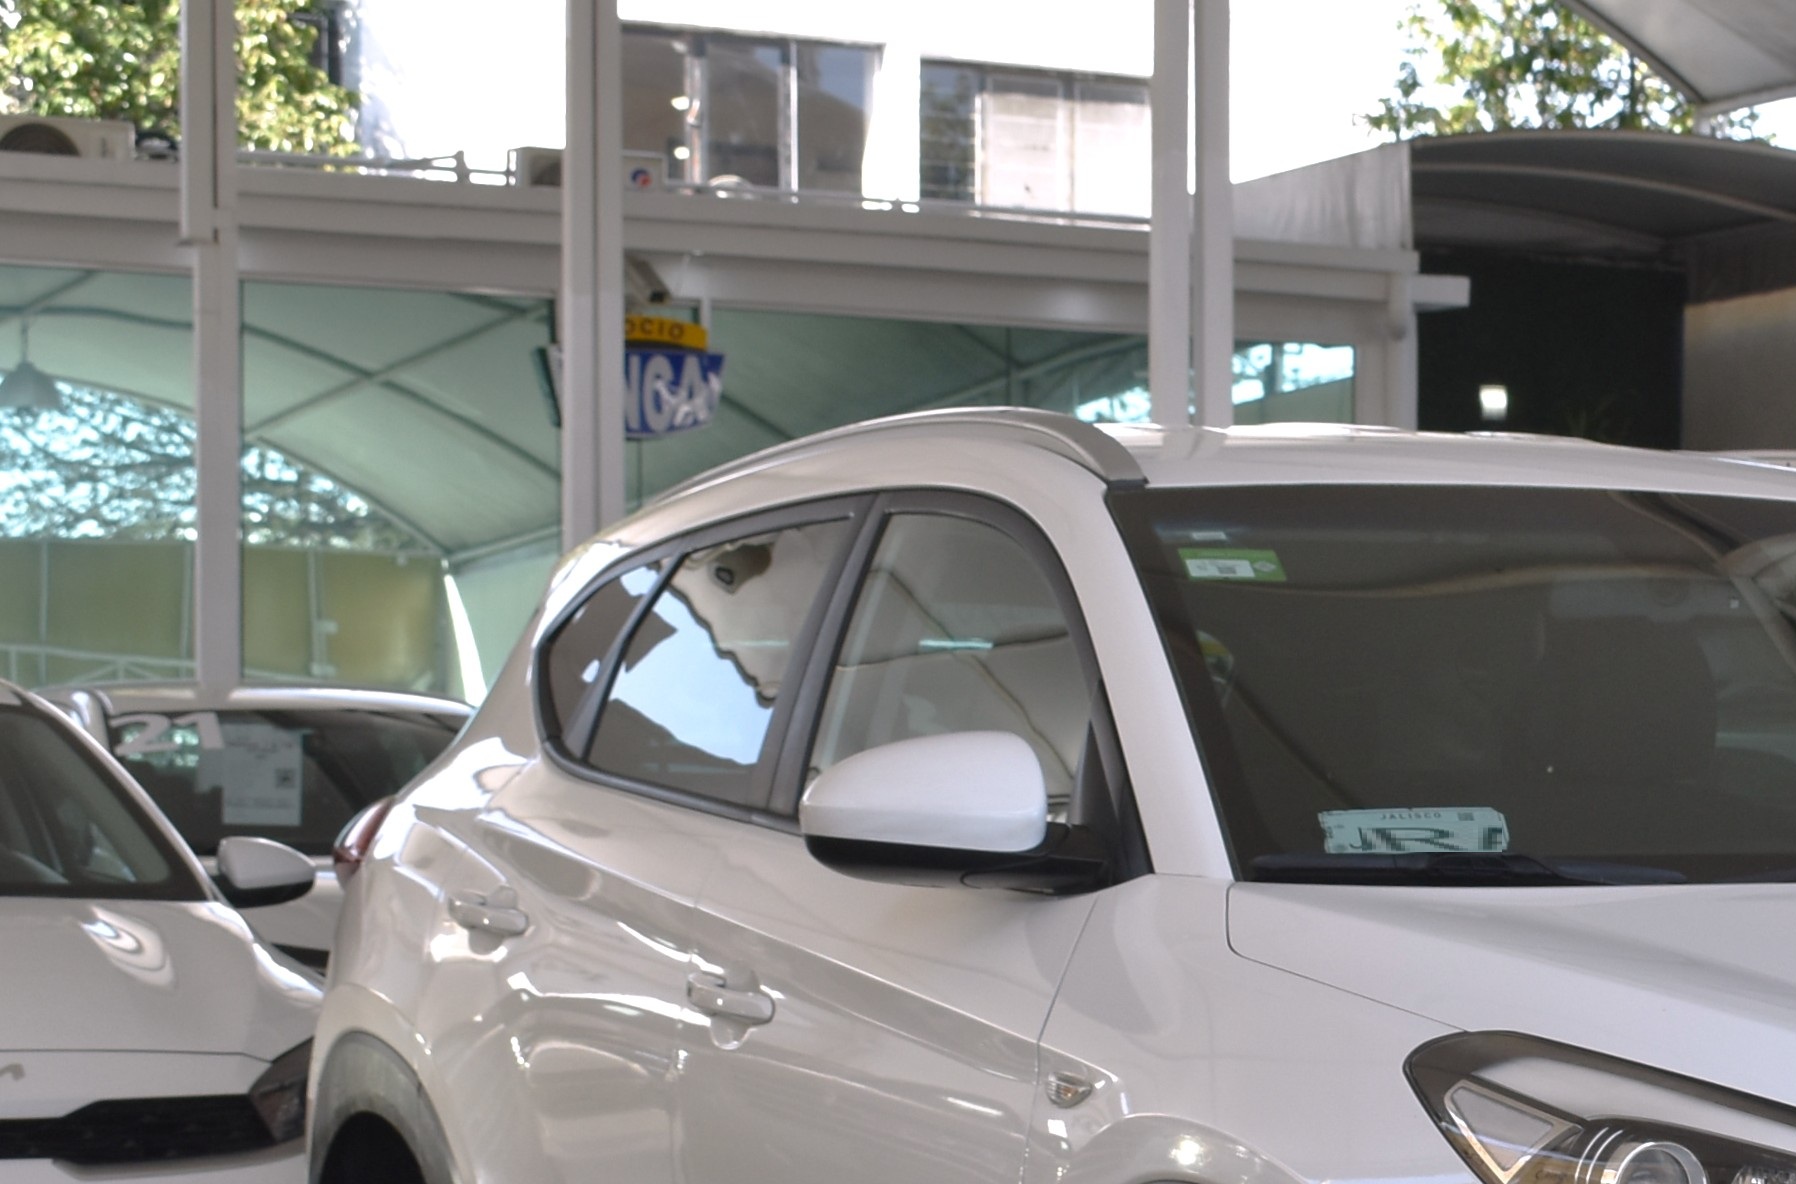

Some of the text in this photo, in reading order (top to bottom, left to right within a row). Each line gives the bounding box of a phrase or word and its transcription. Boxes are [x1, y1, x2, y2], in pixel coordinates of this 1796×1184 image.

[625, 316, 685, 341] OCIO
[108, 710, 225, 756] 21
[1380, 812, 1442, 820] JALISCO
